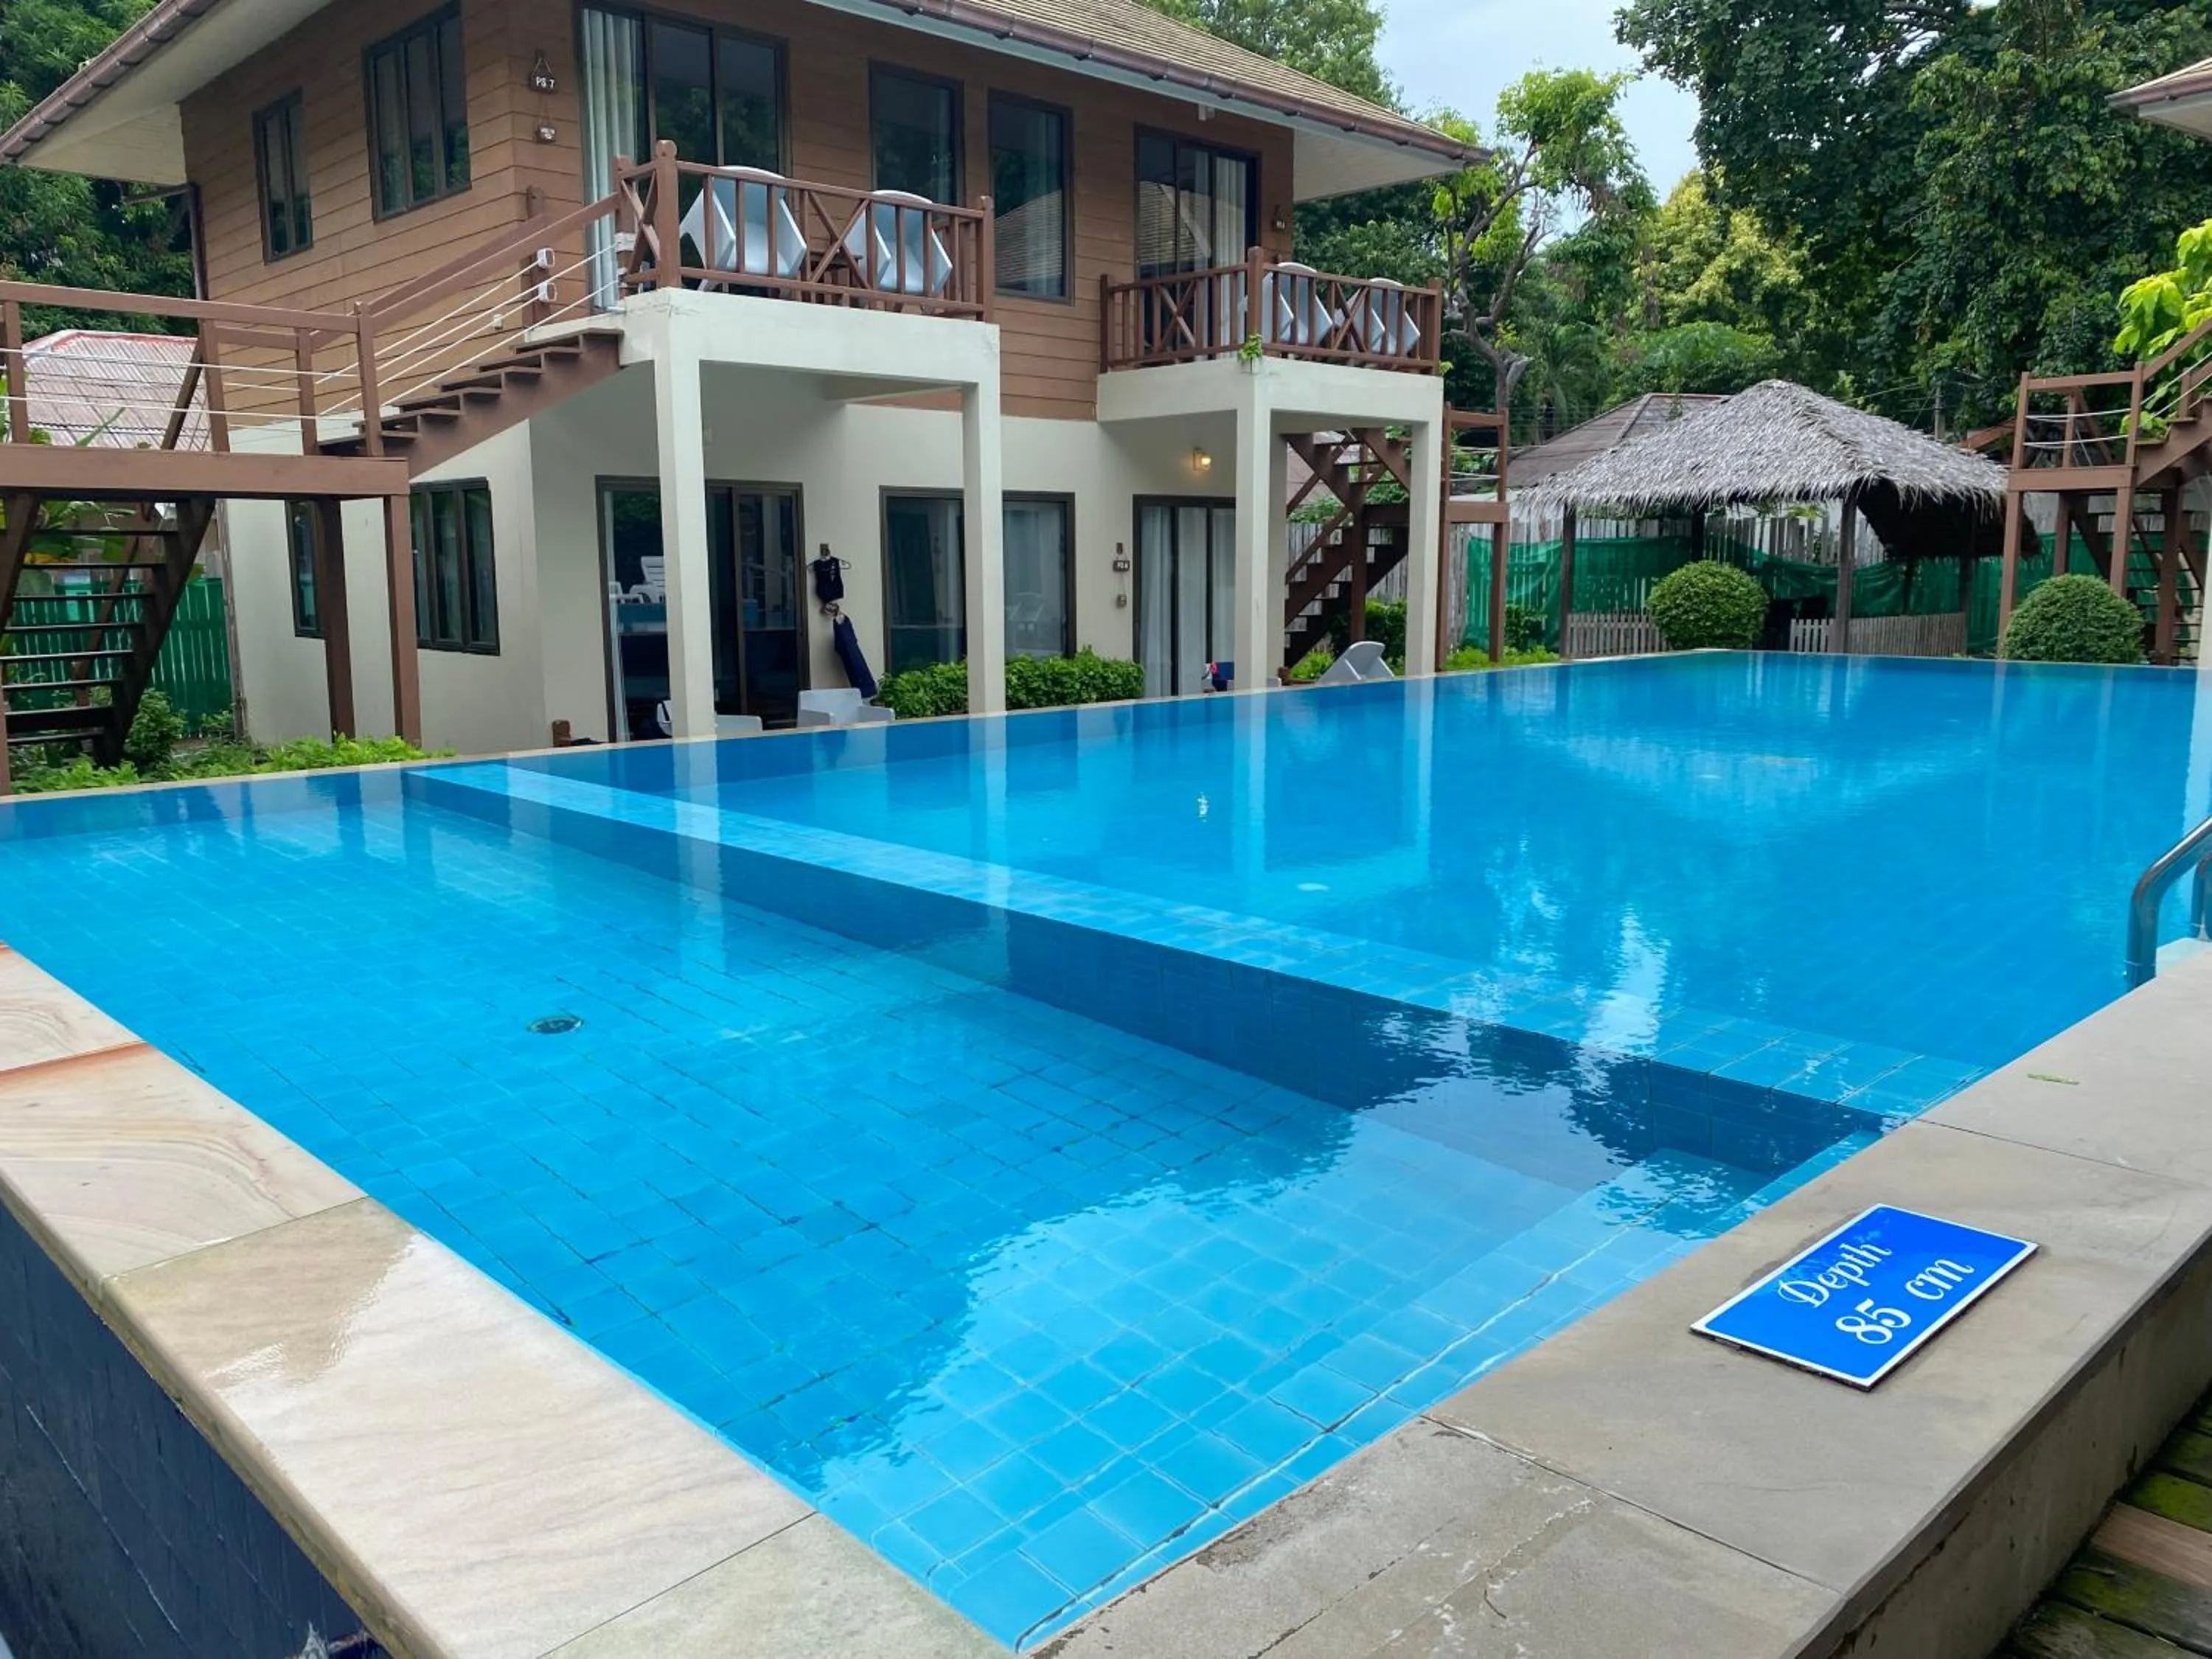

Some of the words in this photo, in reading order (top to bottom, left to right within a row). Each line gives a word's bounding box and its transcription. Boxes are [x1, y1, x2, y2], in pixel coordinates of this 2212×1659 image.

[1778, 1242, 1892, 1308] Depth
[1835, 1298, 1912, 1345] 85
[1905, 1258, 1976, 1301] cm
